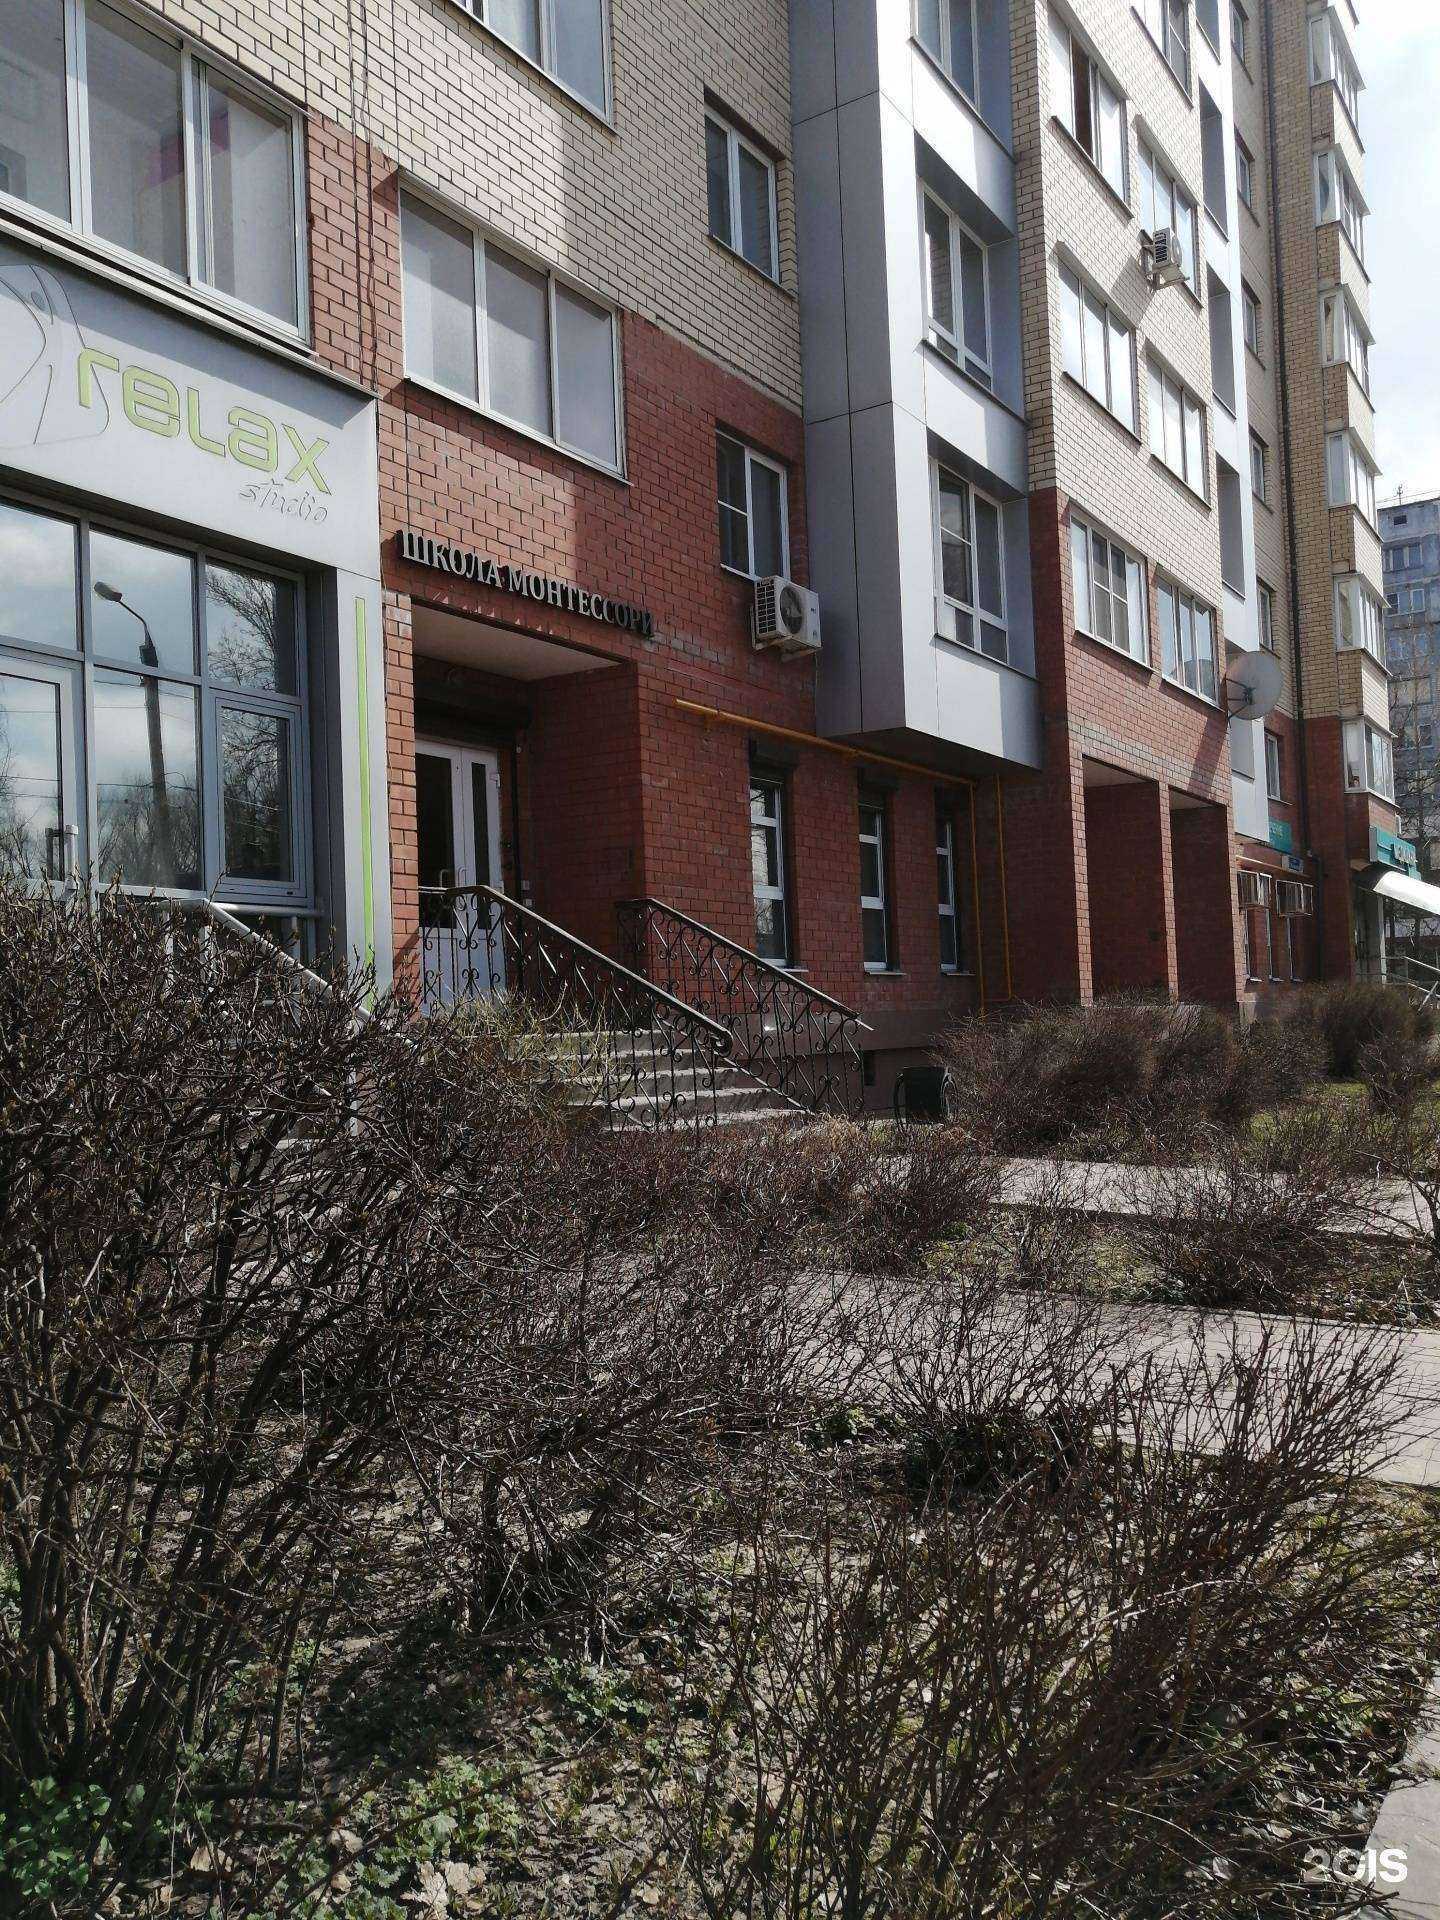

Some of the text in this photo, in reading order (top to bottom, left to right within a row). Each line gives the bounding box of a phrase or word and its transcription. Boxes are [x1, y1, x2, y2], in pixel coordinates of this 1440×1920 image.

[239, 478, 328, 523] studio
[401, 530, 653, 635] ШКОЛА МОНТЕССОРИ
